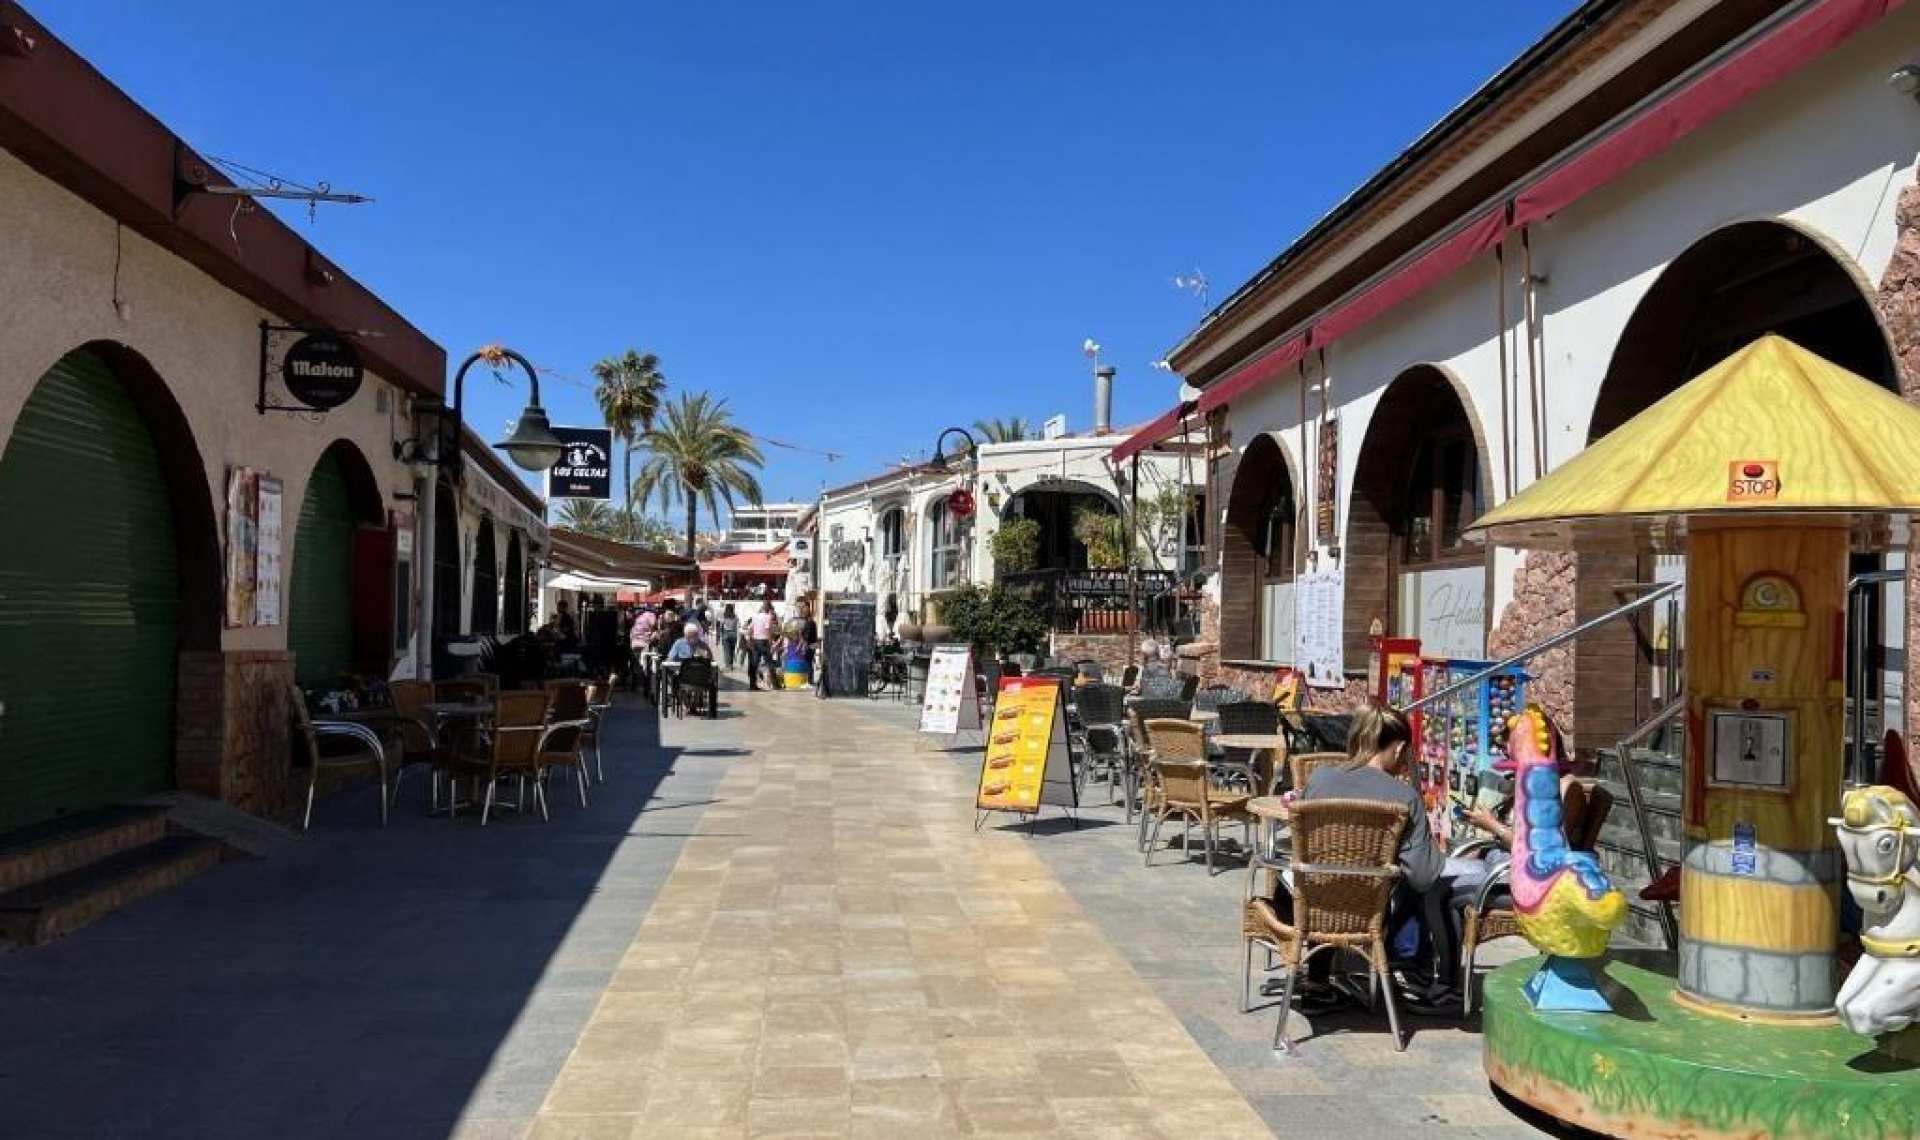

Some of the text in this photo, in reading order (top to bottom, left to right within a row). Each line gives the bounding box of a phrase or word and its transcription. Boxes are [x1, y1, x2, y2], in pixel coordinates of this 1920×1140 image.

[292, 361, 354, 378] Mahou
[553, 467, 572, 477] LOS
[1732, 479, 1774, 495] STOP
